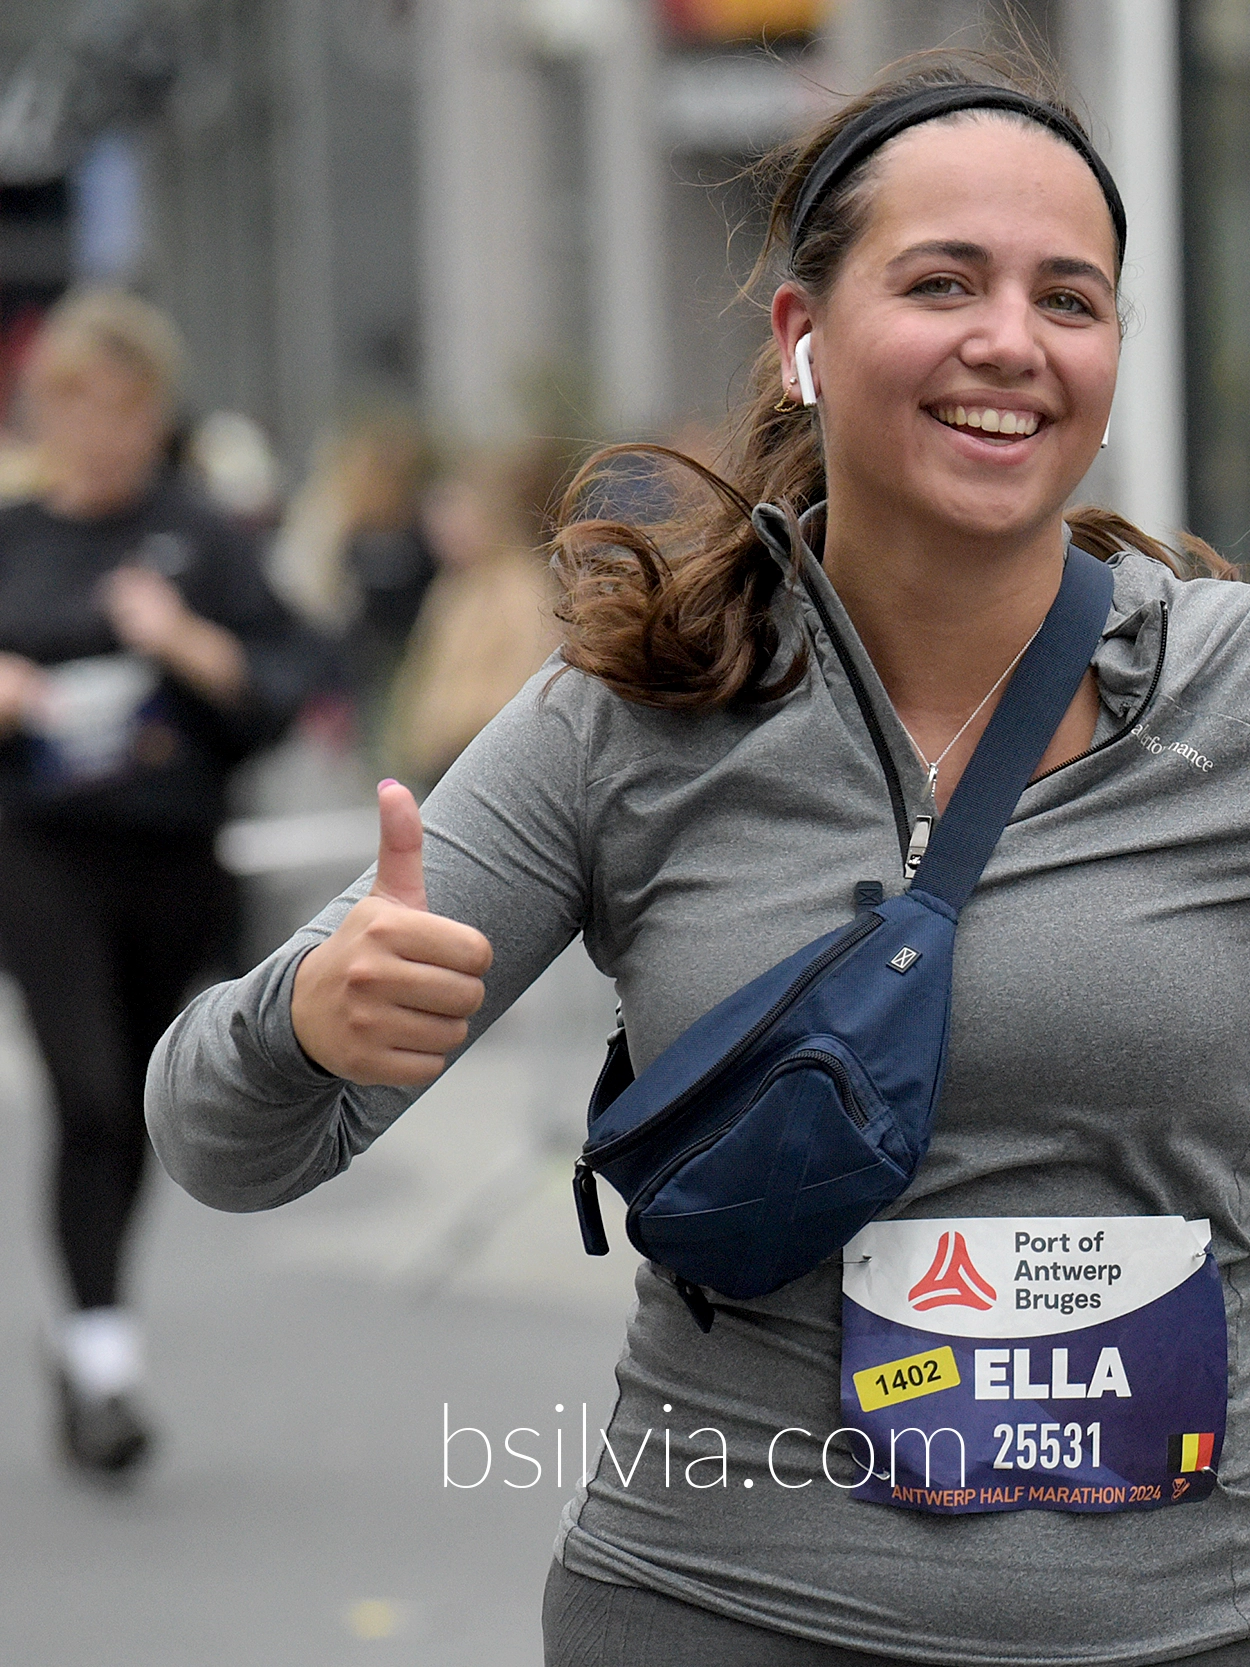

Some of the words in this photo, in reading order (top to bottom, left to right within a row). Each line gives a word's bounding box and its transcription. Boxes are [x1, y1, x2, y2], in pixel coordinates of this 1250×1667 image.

[1015, 1231, 1070, 1253] Port
[1078, 1231, 1105, 1252] of
[1013, 1260, 1122, 1285] Antwerp
[1015, 1288, 1102, 1315] Bruges
[874, 1359, 941, 1396] 1402
[974, 1347, 1132, 1400] ELLA
[992, 1422, 1101, 1470] 25531
[891, 1484, 976, 1507] ANTWERP
[980, 1486, 1024, 1504] HALF
[1028, 1485, 1125, 1504] MARATHON
[1128, 1485, 1161, 1502] 2024
